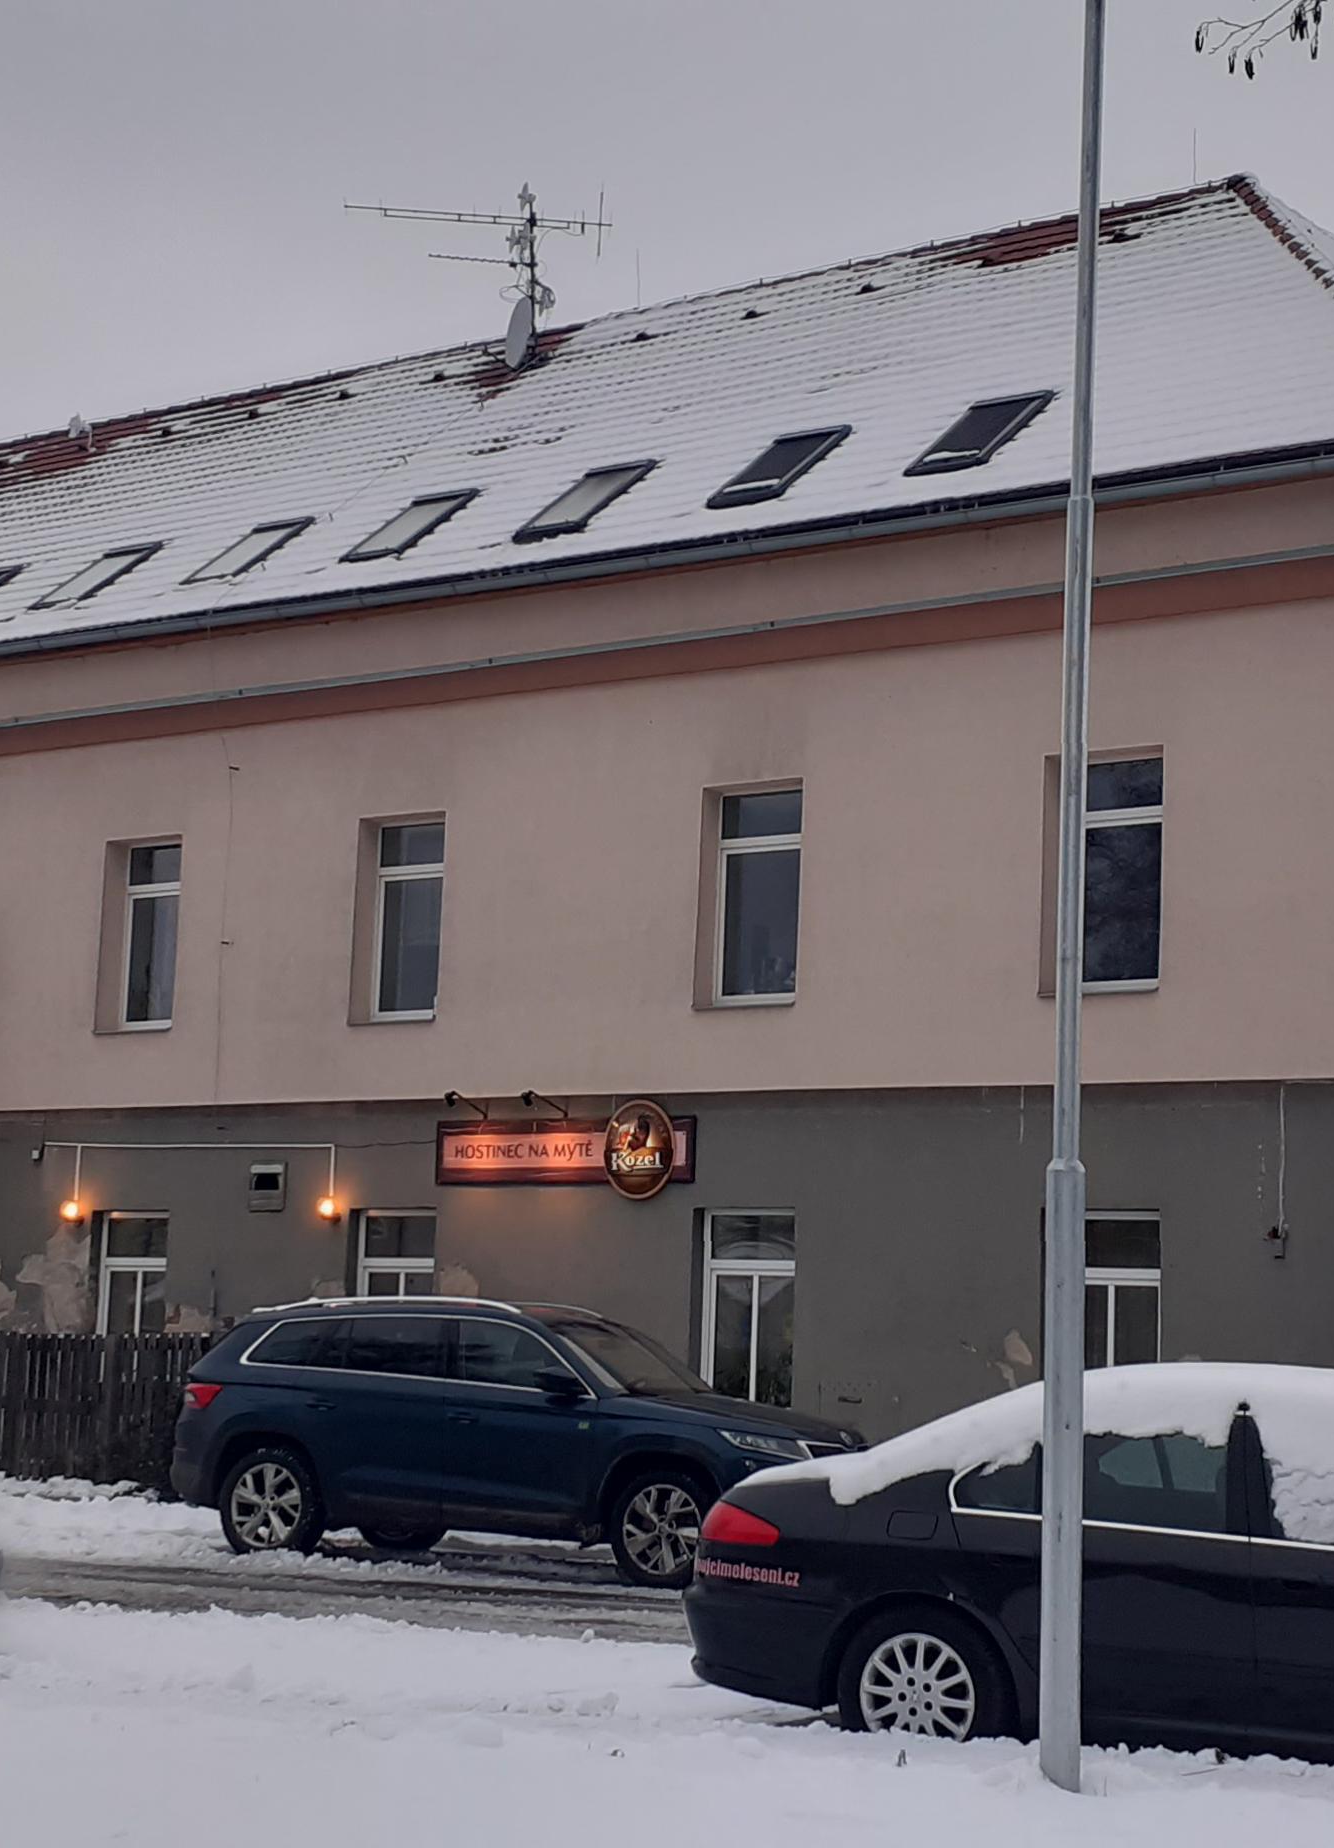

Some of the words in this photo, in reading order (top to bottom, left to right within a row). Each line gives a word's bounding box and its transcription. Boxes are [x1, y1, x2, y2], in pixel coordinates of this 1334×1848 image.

[454, 1144, 525, 1160] HOSTINEC
[528, 1143, 549, 1158] NA
[611, 1151, 664, 1173] Kozel
